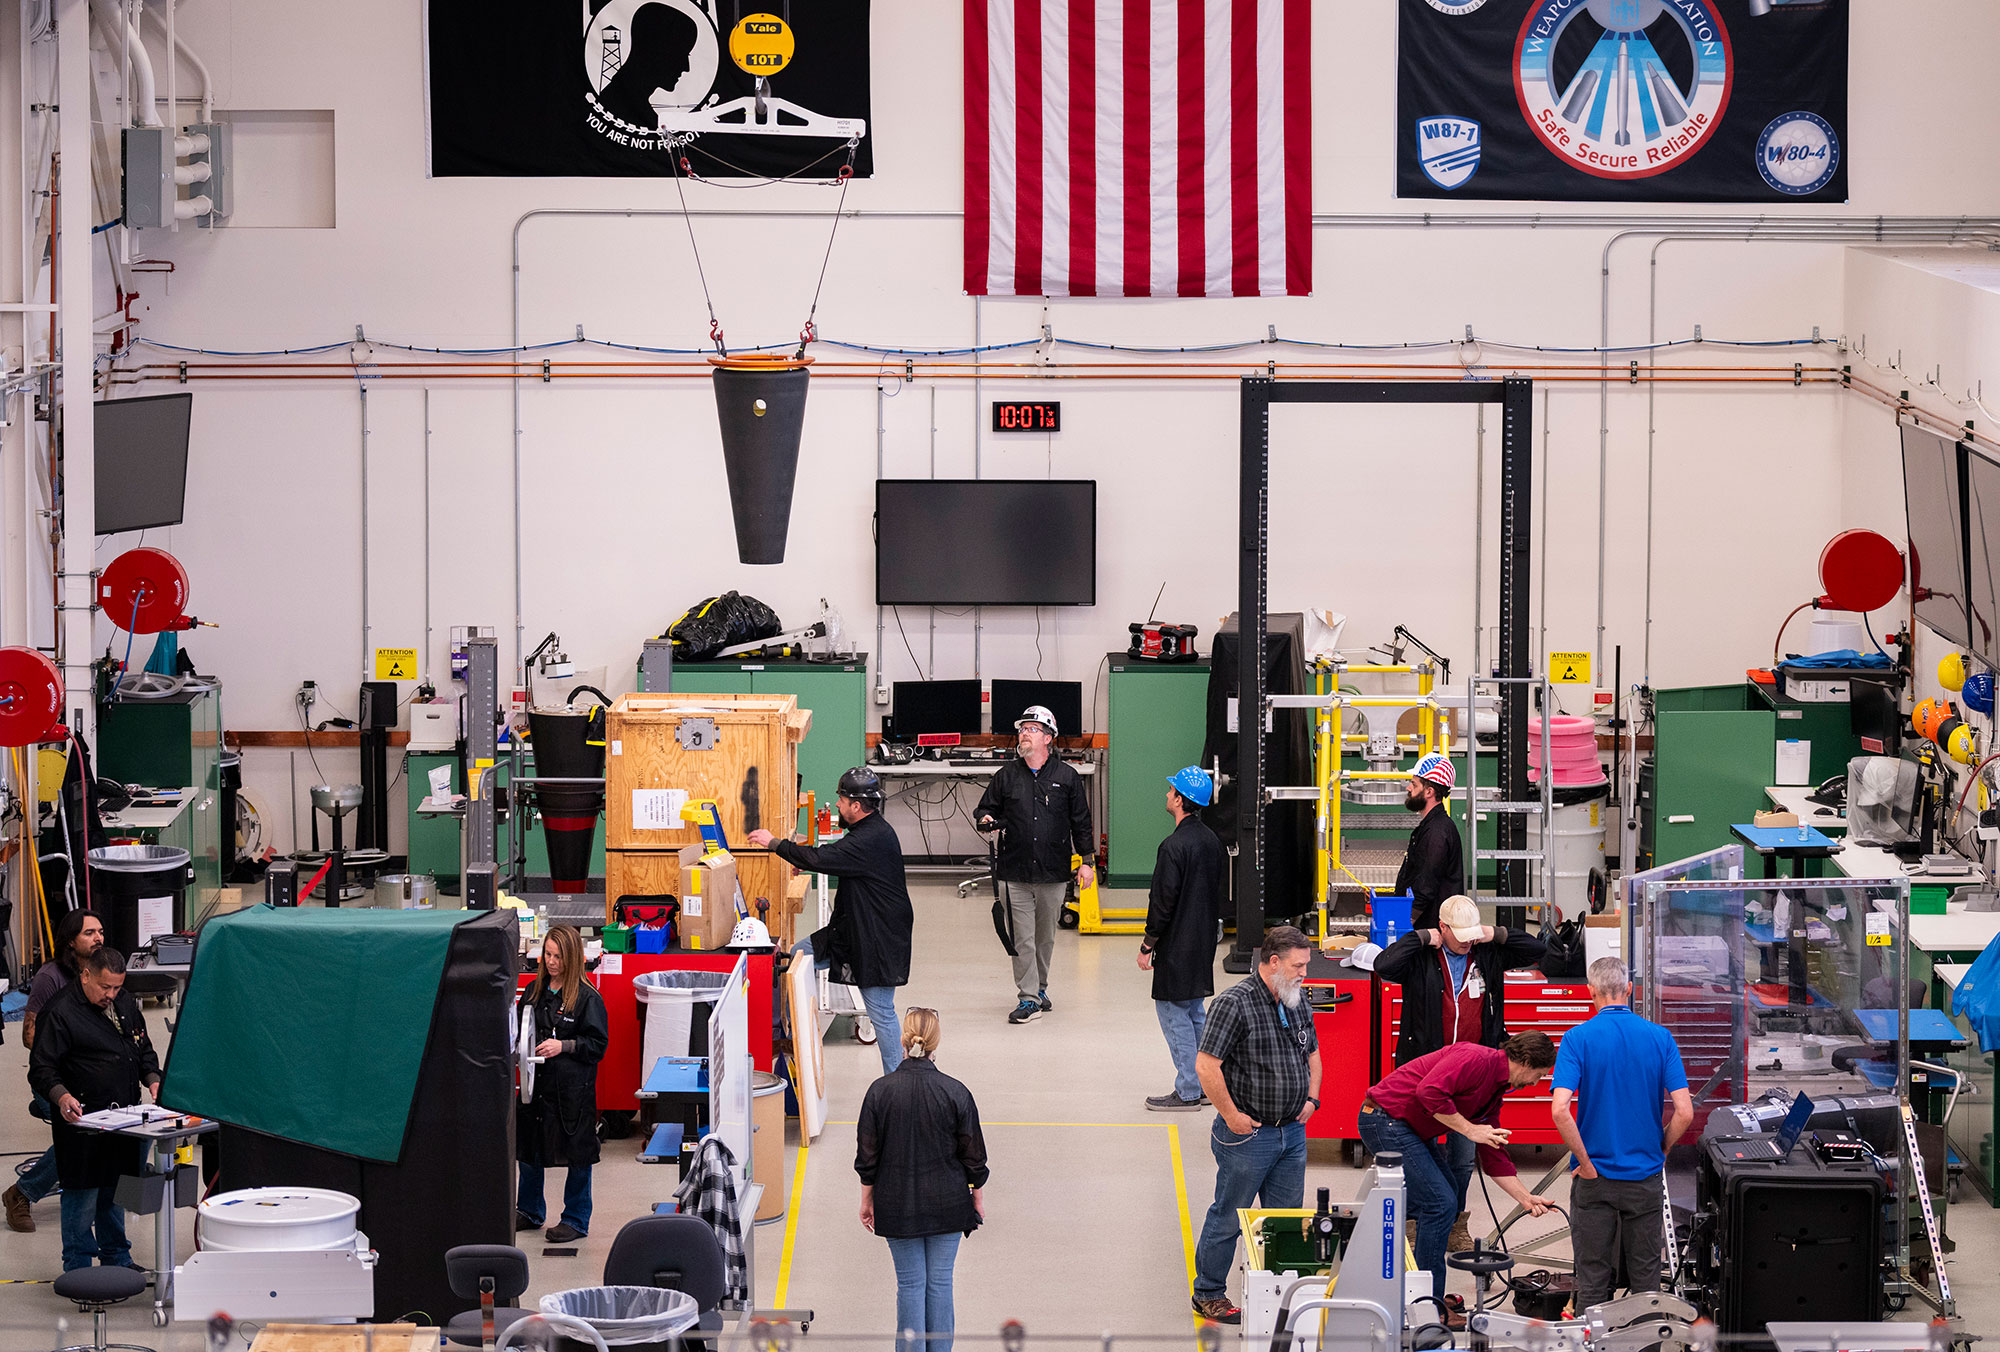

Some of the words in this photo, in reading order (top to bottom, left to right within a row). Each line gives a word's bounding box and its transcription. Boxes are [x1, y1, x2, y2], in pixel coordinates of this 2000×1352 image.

[751, 24, 777, 33] Yale
[751, 55, 777, 65] 10T
[585, 113, 607, 134] YOU
[606, 130, 629, 146] ARE
[630, 138, 655, 150] NOT
[1422, 123, 1476, 142] W87-1
[1537, 109, 1570, 147] Safe
[1575, 143, 1638, 168] Secure
[1646, 111, 1709, 164] Reliable
[1000, 405, 1045, 428] 10:07
